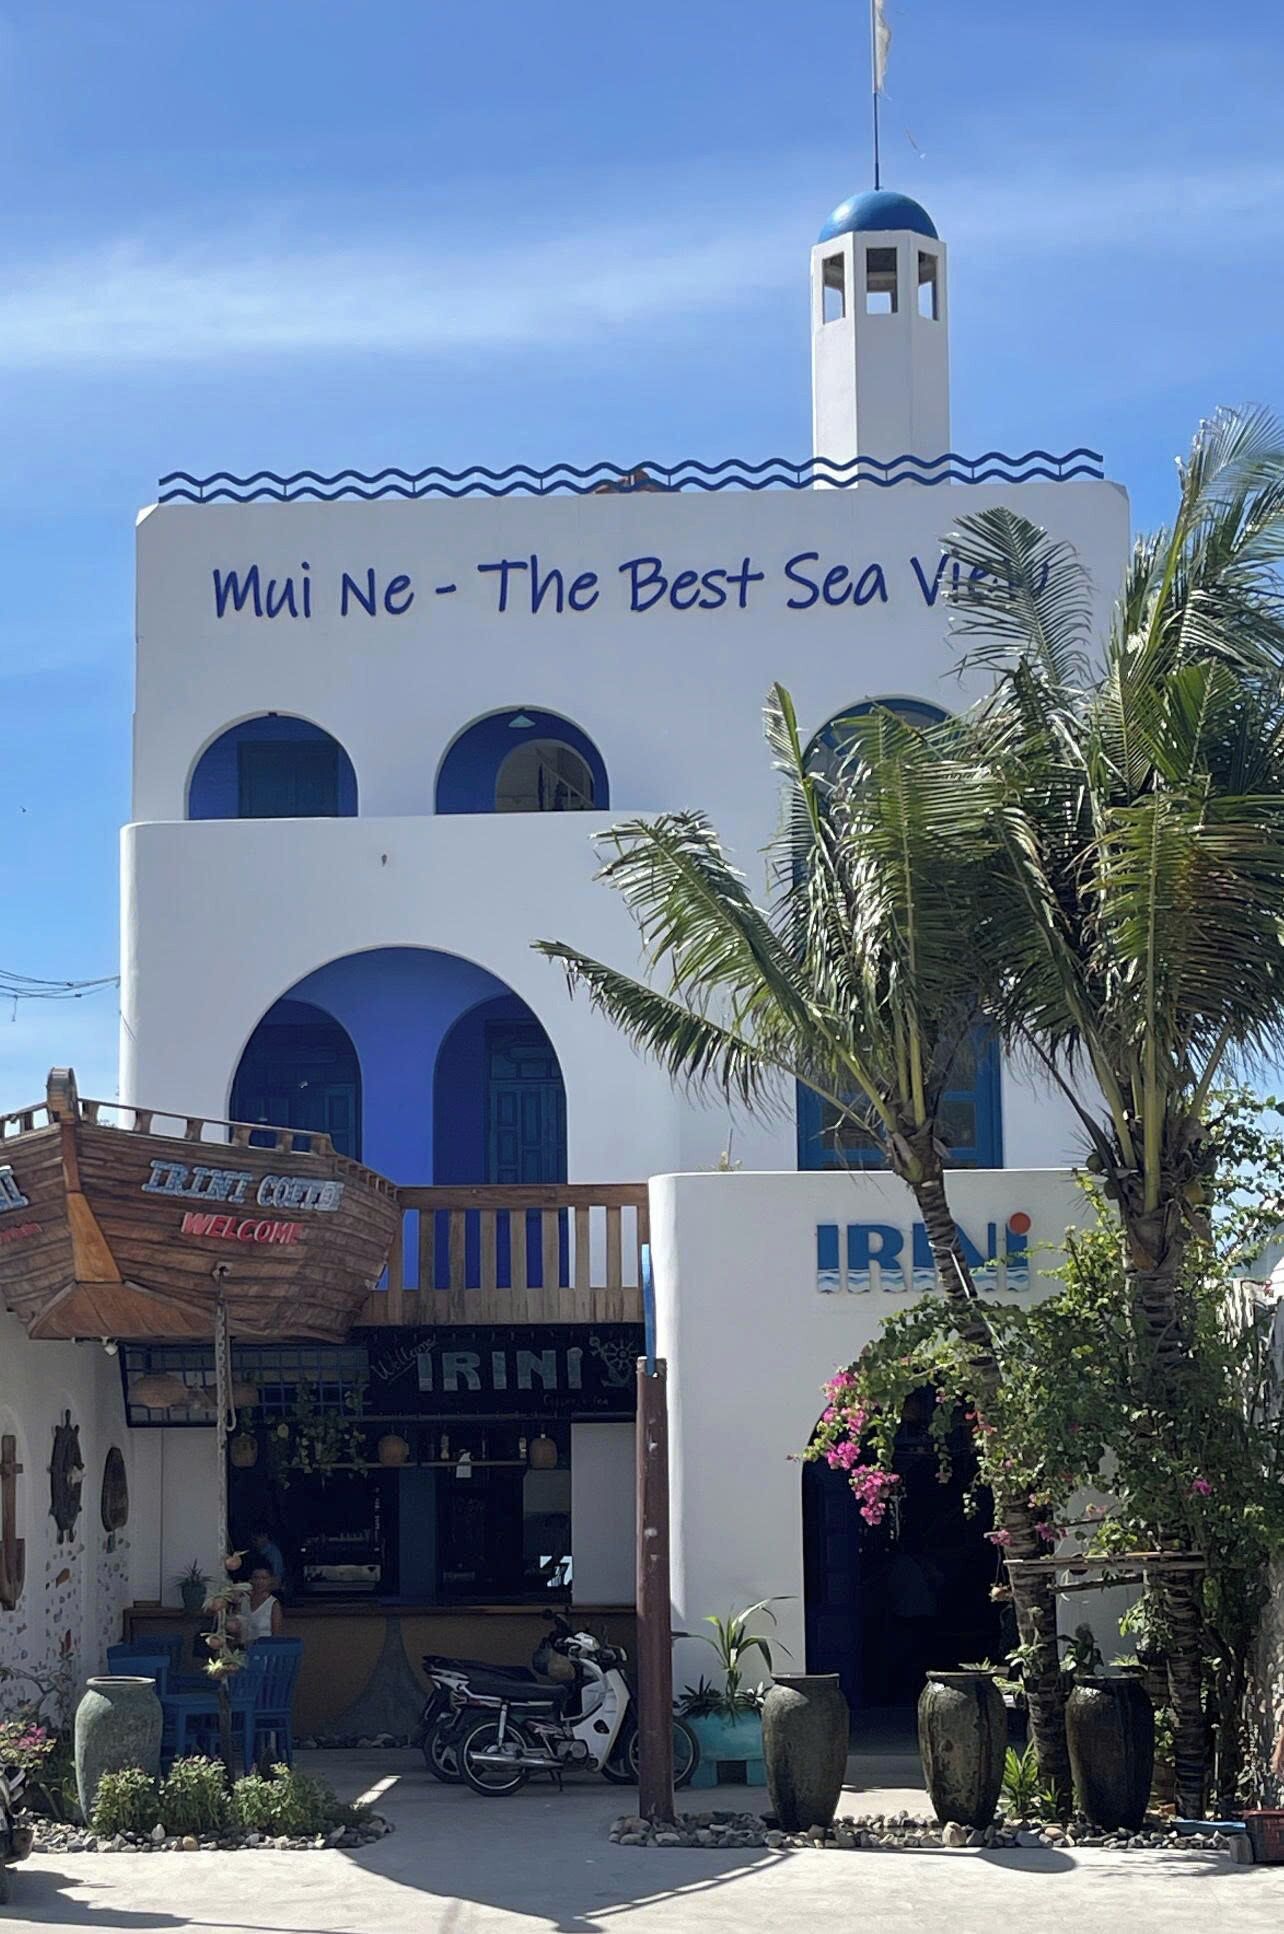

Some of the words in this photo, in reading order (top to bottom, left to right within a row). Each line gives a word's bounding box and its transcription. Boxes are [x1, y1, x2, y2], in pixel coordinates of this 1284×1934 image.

[212, 562, 312, 618] Mui
[341, 567, 413, 616] Ne
[479, 554, 600, 613] The
[618, 556, 765, 613] Best
[784, 551, 889, 607] Sea
[141, 1159, 254, 1205] IRINI
[816, 1213, 1031, 1294] IRINI
[416, 1347, 584, 1392] IRINI
